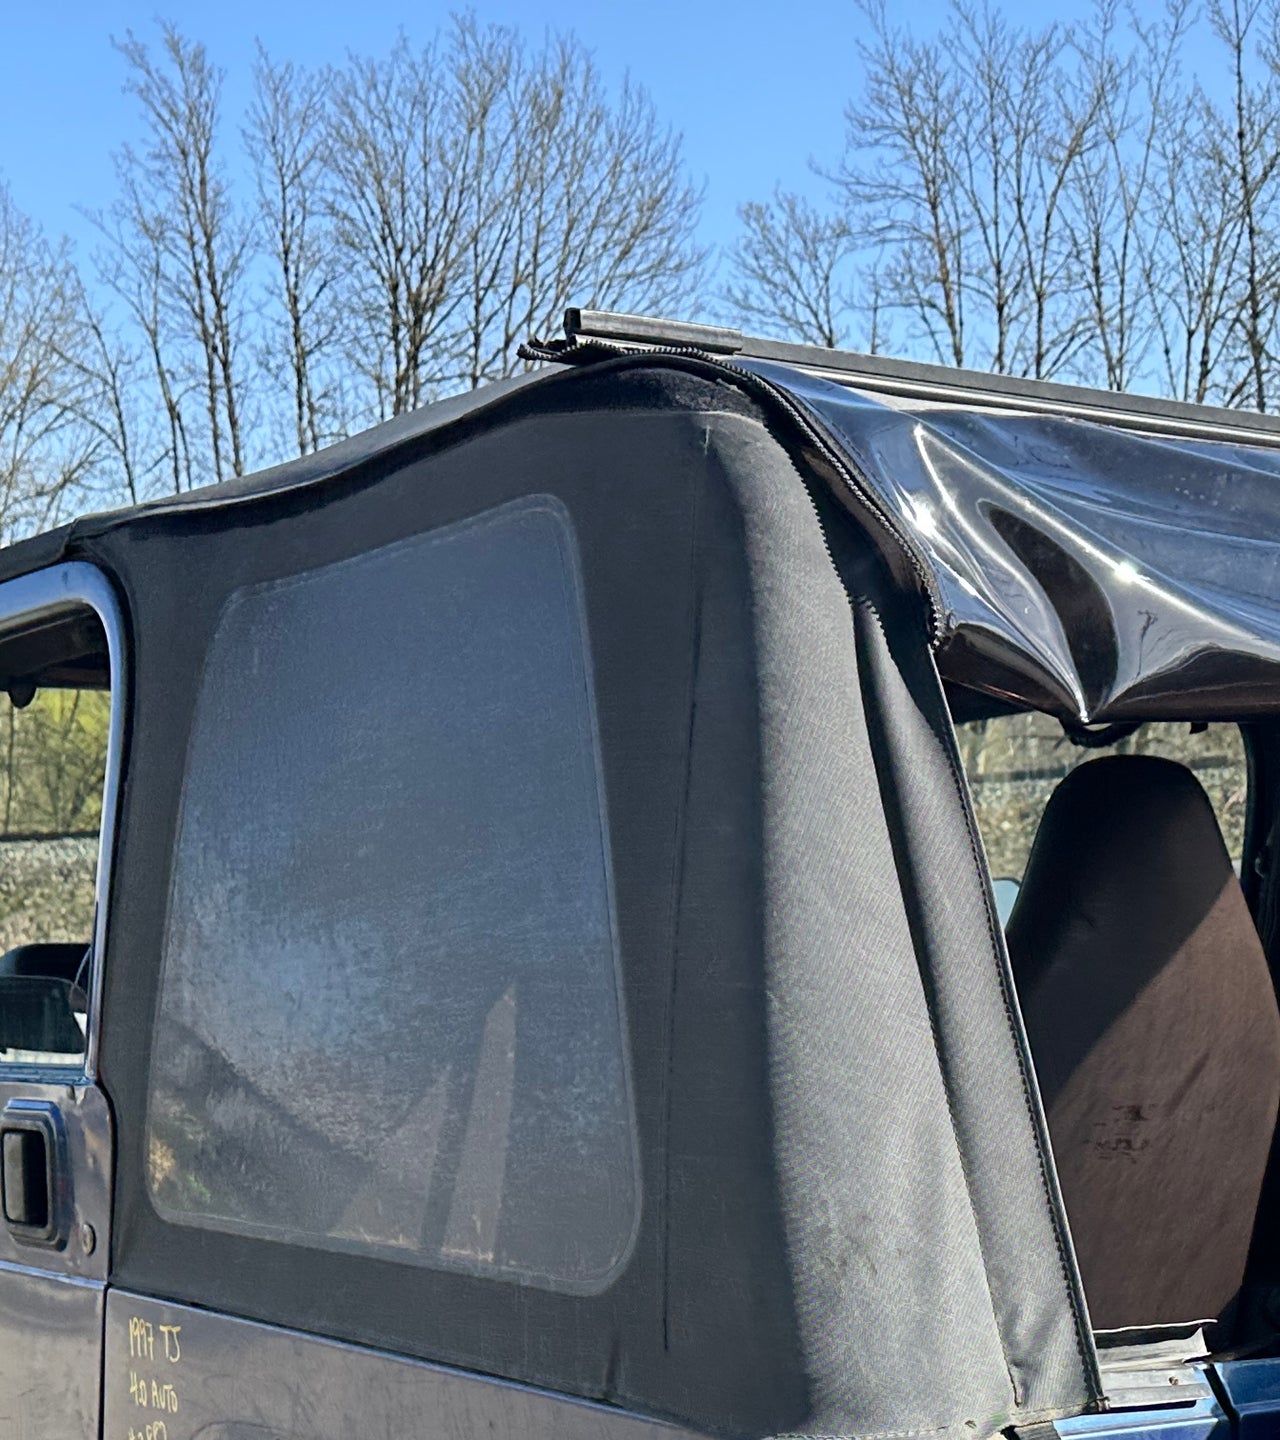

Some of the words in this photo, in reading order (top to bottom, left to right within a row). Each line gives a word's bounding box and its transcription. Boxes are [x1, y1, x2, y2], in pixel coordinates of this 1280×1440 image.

[129, 1316, 155, 1361] 1997
[160, 1324, 181, 1363] TJ
[152, 1379, 179, 1413] AUTO
